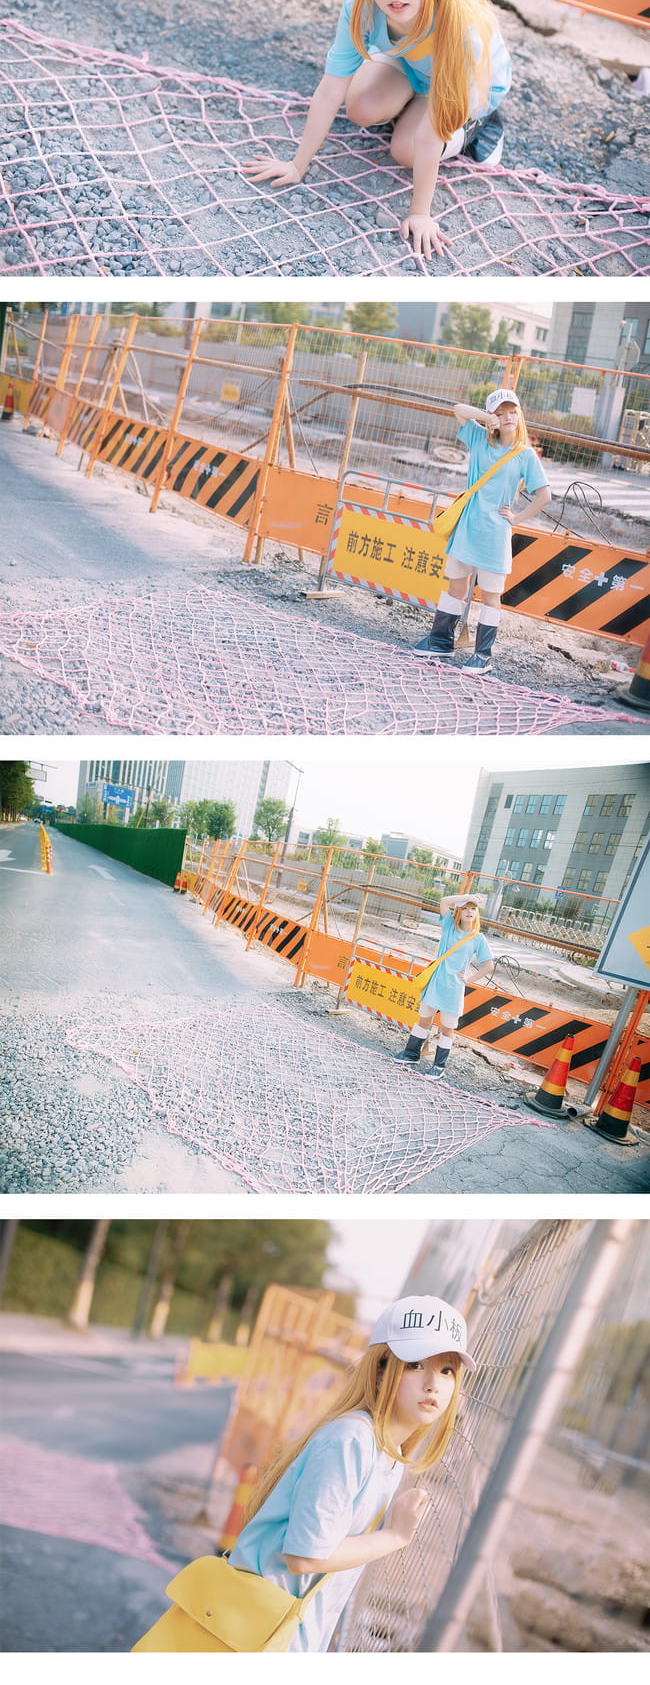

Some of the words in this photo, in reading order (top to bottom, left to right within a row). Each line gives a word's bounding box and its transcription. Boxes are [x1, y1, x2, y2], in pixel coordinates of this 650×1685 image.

[346, 530, 397, 563] 前方施工
[401, 545, 450, 581] 注意安
[355, 975, 387, 998] 前方施工
[400, 1309, 463, 1347] 血小板
